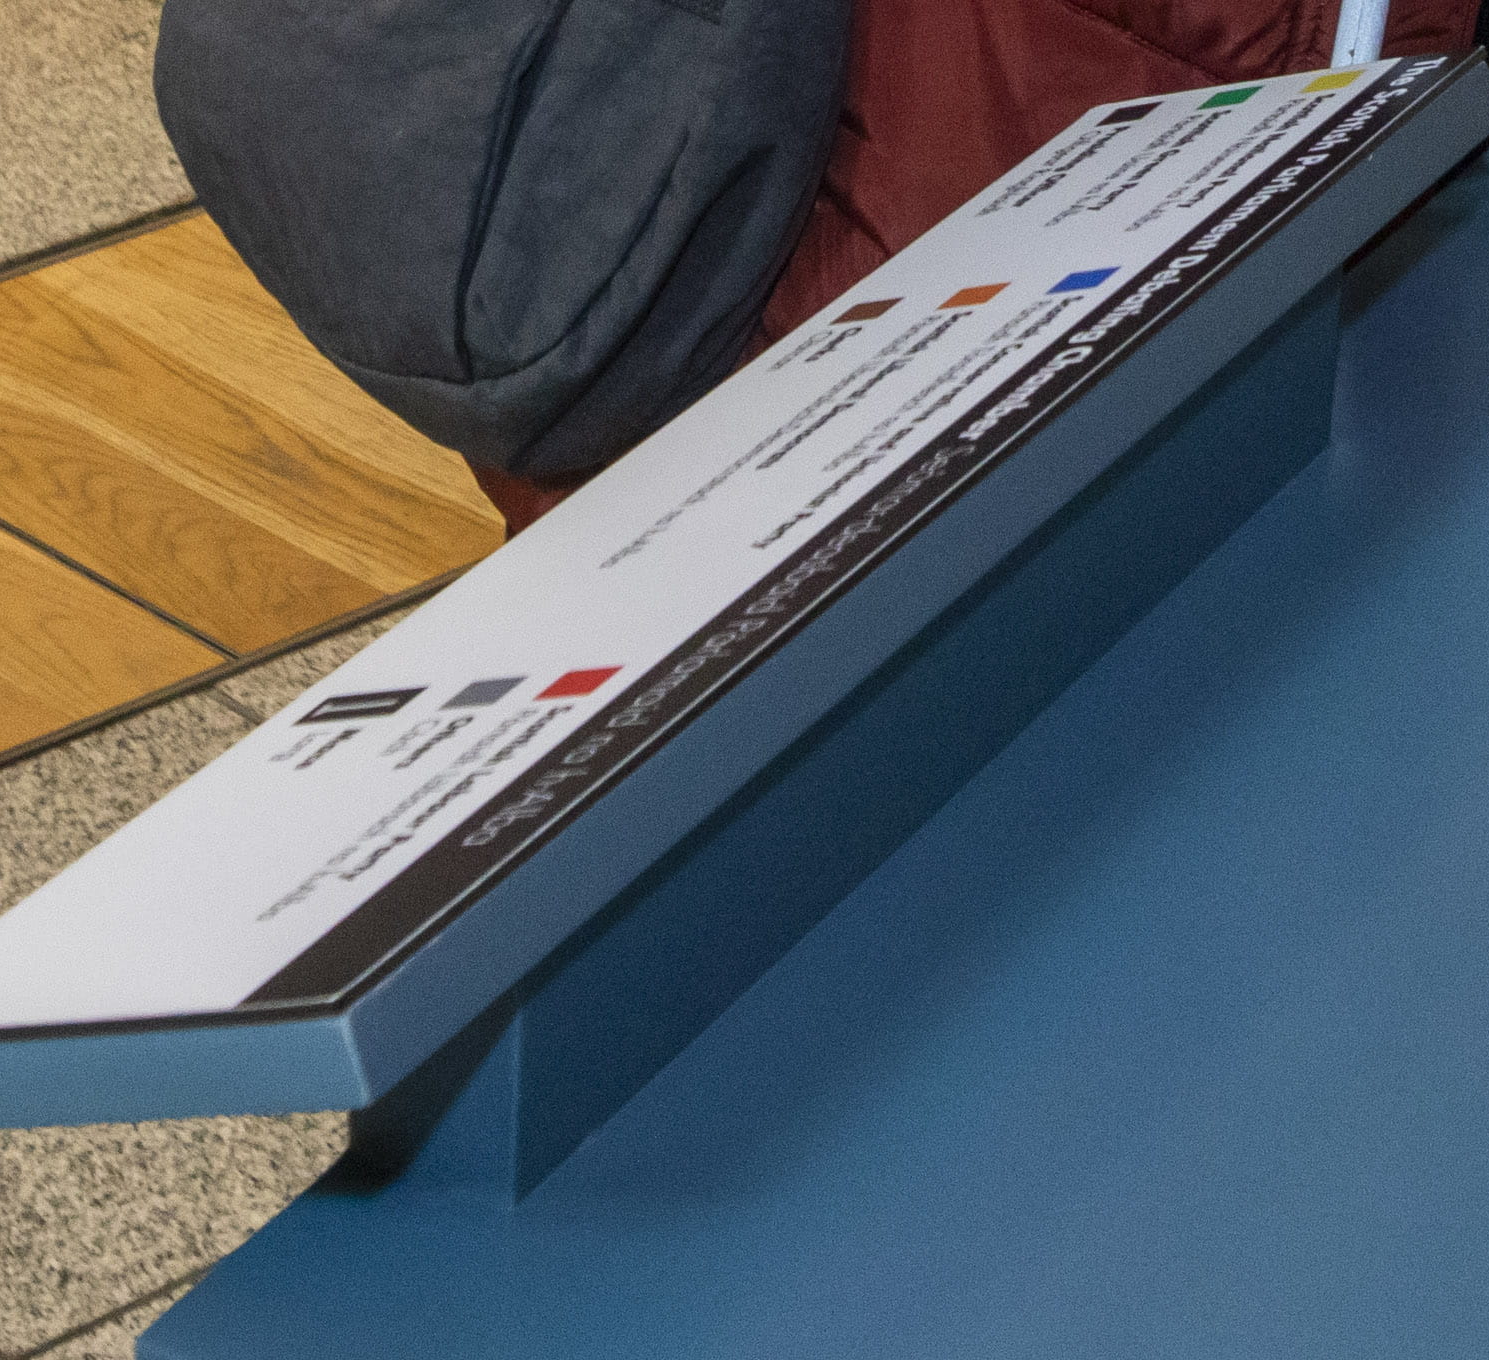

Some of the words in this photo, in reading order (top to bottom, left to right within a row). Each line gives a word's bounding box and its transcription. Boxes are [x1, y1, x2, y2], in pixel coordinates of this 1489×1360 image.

[1389, 56, 1447, 87] The
[1173, 109, 1232, 148] Scottish
[1277, 93, 1335, 131] Scottish
[1309, 87, 1409, 152] Scottish
[1054, 125, 1131, 173] Presiding
[1129, 148, 1181, 181] Green
[1219, 132, 1286, 178] National
[1013, 172, 1067, 208] Officer
[1087, 182, 1138, 212] Party
[1177, 178, 1229, 209] Party
[1188, 153, 1329, 252] Parliament
[1017, 295, 1084, 340] Scottish
[1068, 253, 1208, 344] Debating
[805, 326, 863, 363] Clerks
[905, 310, 973, 356] Scottish
[847, 359, 907, 400] Liberal
[911, 342, 1024, 424] Conservative
[959, 345, 1093, 441] Chamber
[756, 401, 855, 470] Democrats
[876, 426, 914, 452] and
[808, 454, 884, 509] Unionist
[752, 511, 814, 550] Party
[296, 728, 361, 769] Mace
[395, 715, 475, 769] Others
[487, 705, 573, 766] Scottish
[562, 733, 614, 765] na
[410, 771, 489, 830] Labour
[461, 769, 587, 847] h-Alba
[339, 833, 413, 882] Party
